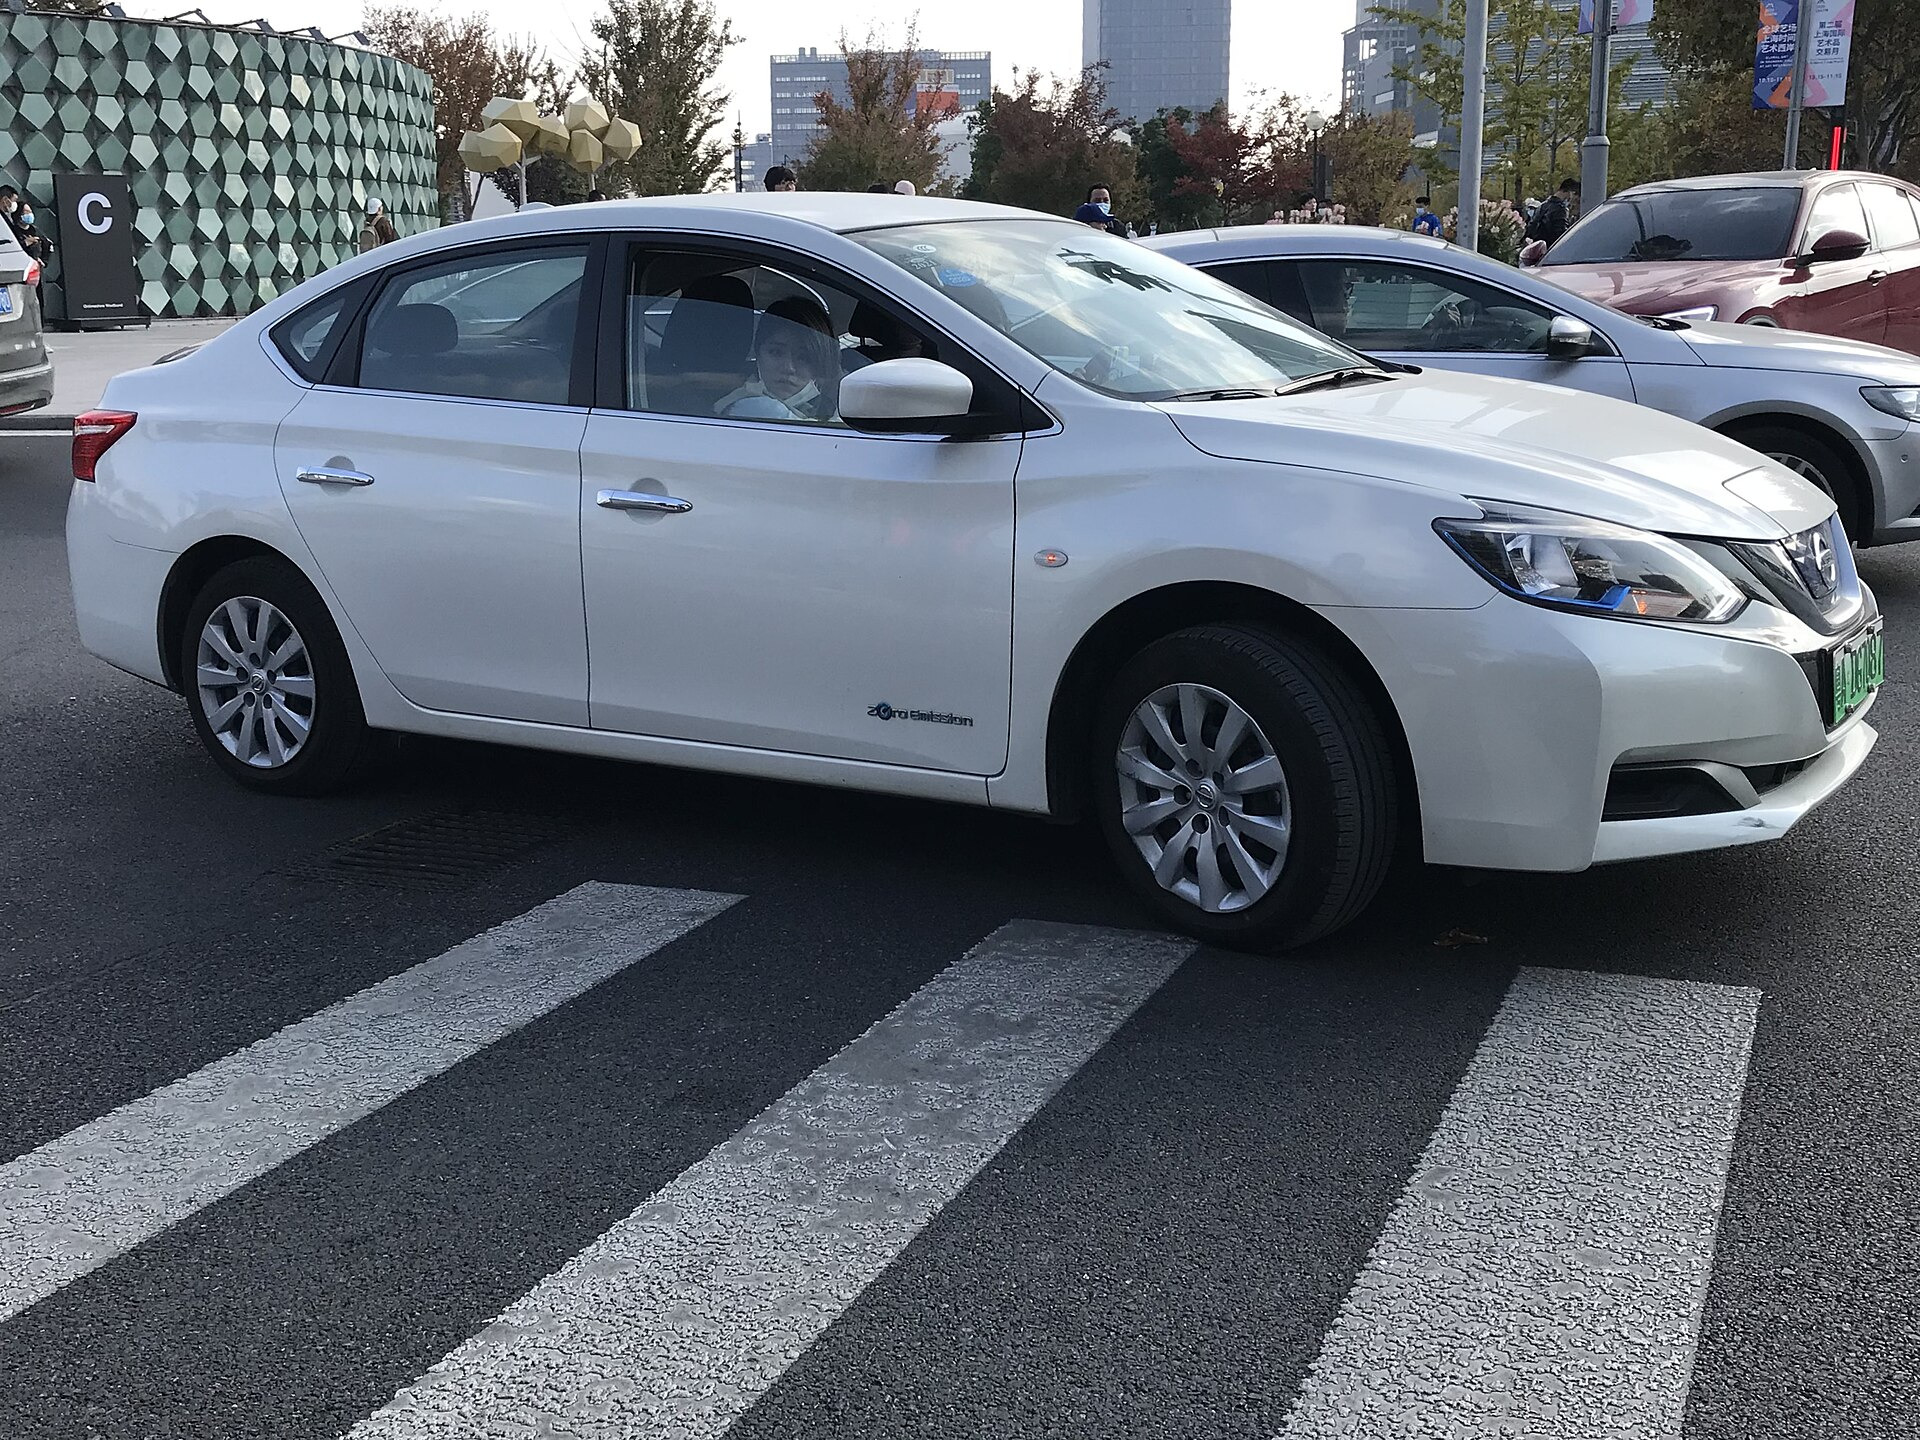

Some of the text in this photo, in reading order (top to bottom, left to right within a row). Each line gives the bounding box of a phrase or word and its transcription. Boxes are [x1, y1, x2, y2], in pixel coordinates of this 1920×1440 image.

[1762, 23, 1797, 34] 全球艺场
[1813, 29, 1846, 38] 上海国际
[1762, 34, 1796, 44] 上海时间
[1817, 38, 1841, 47] 艺术品
[1761, 43, 1795, 53] 艺术西岸
[1816, 47, 1840, 56] 交易月
[77, 192, 113, 234] C
